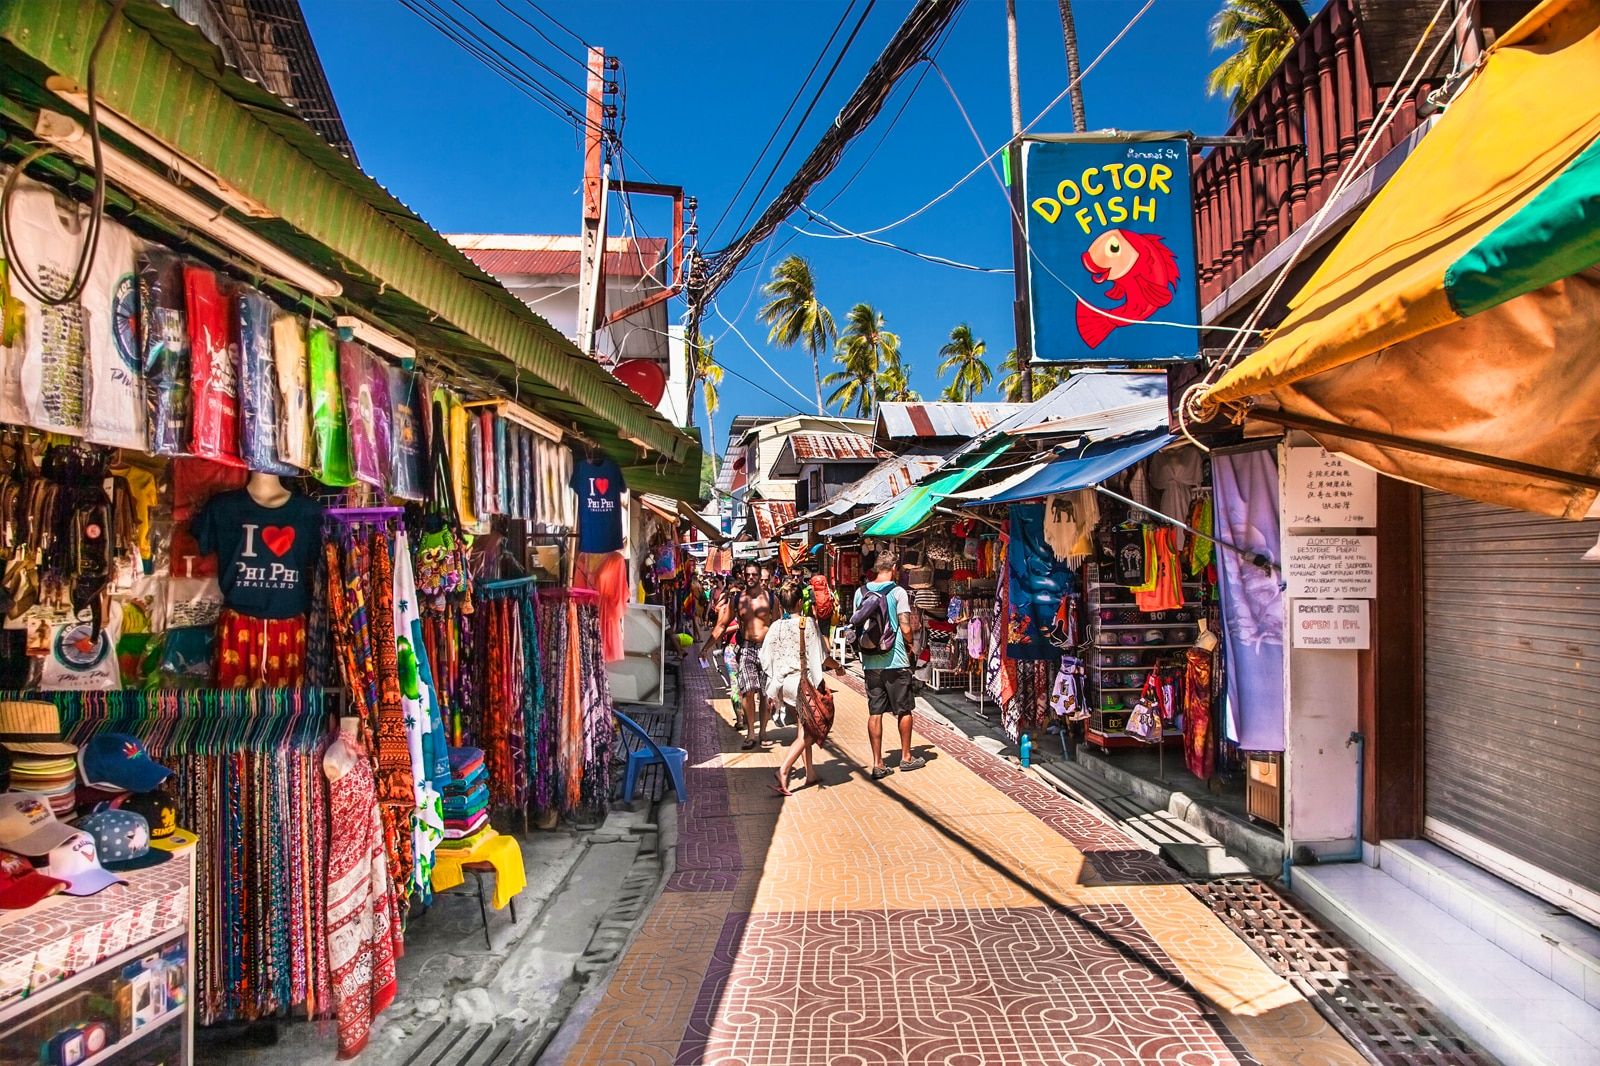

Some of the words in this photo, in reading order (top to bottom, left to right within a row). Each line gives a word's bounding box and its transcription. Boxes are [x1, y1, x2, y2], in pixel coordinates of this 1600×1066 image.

[1032, 163, 1173, 224] DOCTOR
[1075, 195, 1157, 234] FISH
[588, 478, 595, 496] I
[600, 498, 614, 508] PHI
[241, 523, 259, 557] I
[1307, 537, 1340, 546] ДОКТОР
[269, 562, 300, 583] PHI
[236, 580, 295, 589] THAILAND
[1304, 585, 1319, 594] 200
[1336, 604, 1360, 614] FISH
[1301, 620, 1331, 630] OPEN
